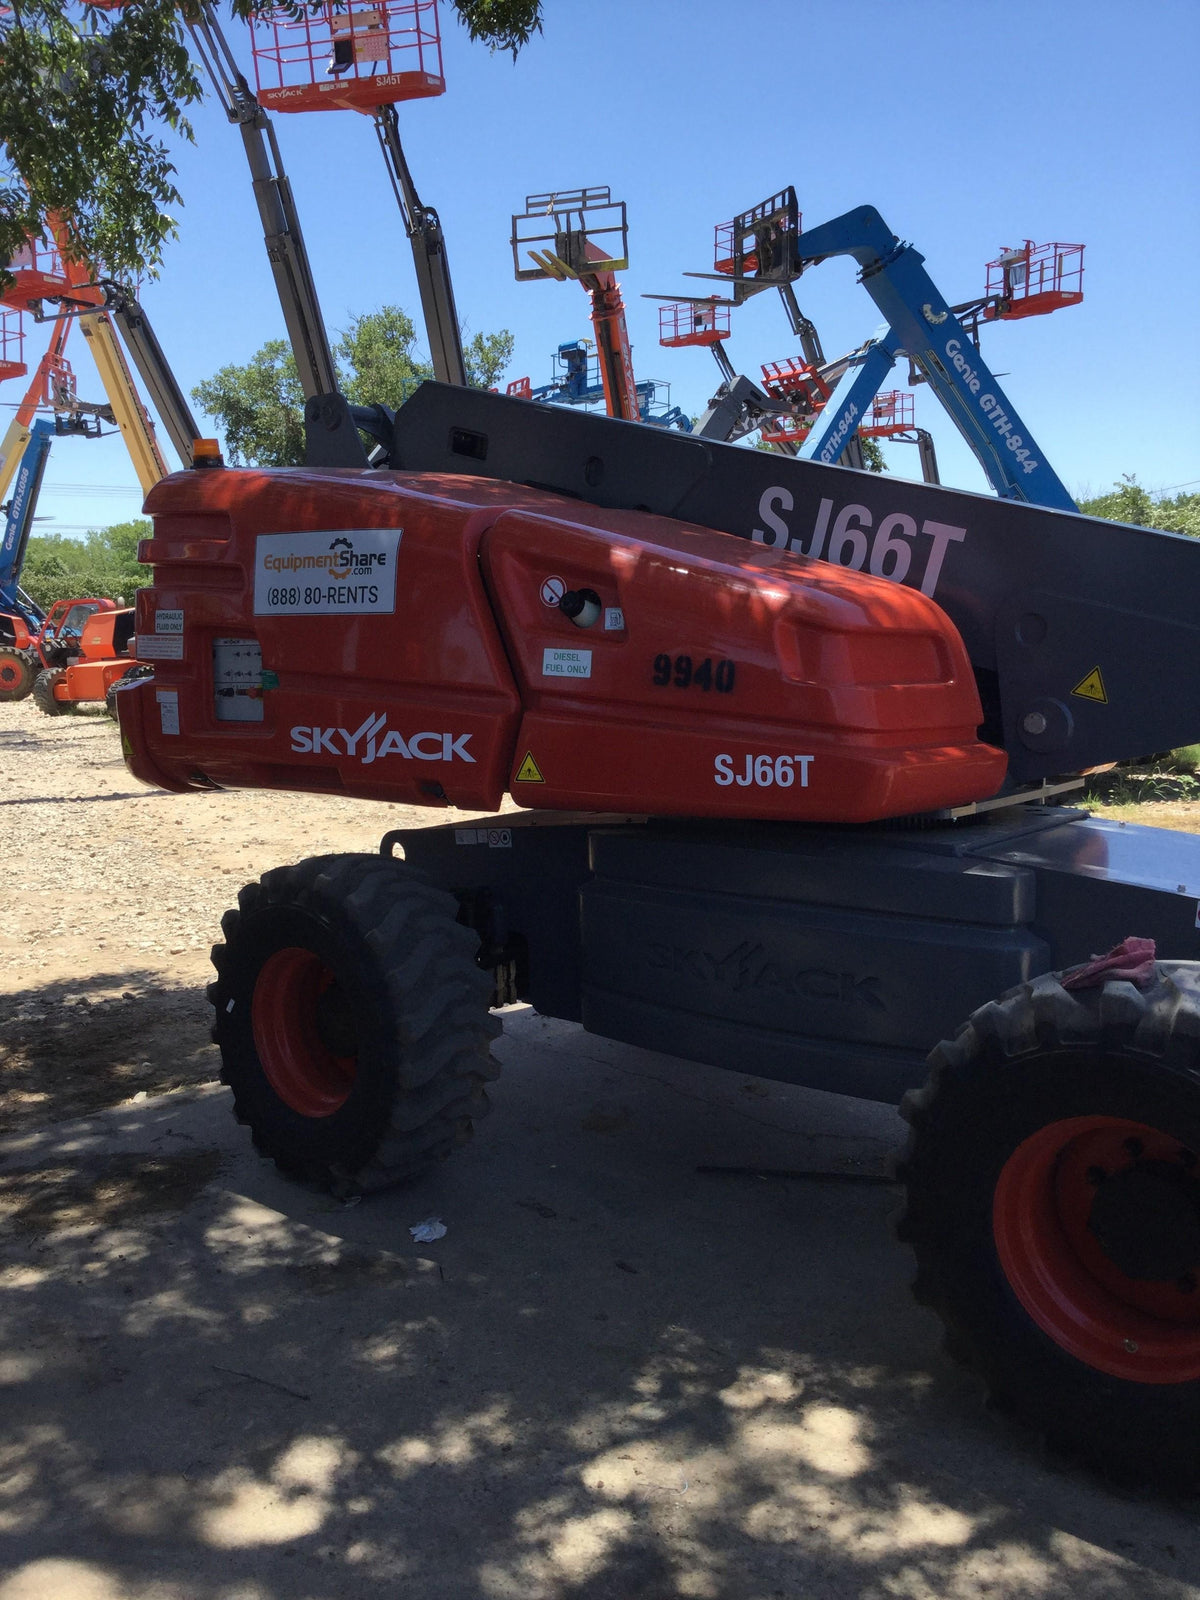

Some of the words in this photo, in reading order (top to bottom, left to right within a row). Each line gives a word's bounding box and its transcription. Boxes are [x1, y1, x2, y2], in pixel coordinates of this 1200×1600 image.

[375, 75, 402, 87] SJ45T
[267, 88, 303, 100] SKYJACK
[945, 339, 980, 396] Genie
[978, 393, 1039, 475] GTH-844
[820, 402, 859, 463] GTH-844
[5, 523, 17, 551] Genie
[752, 485, 967, 599] SJ66T
[263, 550, 387, 573] EquipmentShare
[351, 567, 372, 576] .com
[267, 586, 301, 606] (888)
[304, 585, 379, 605] 80-RENTS
[156, 612, 183, 621] HYDRAULIC
[156, 622, 169, 631] FLUID
[170, 622, 183, 631] ONLY
[553, 652, 581, 662] DIESEL
[545, 663, 565, 673] FUEL
[567, 664, 588, 674] ONLY
[652, 653, 736, 694] 9940
[290, 712, 477, 764] SKYJACK
[714, 753, 815, 788] SJ66T
